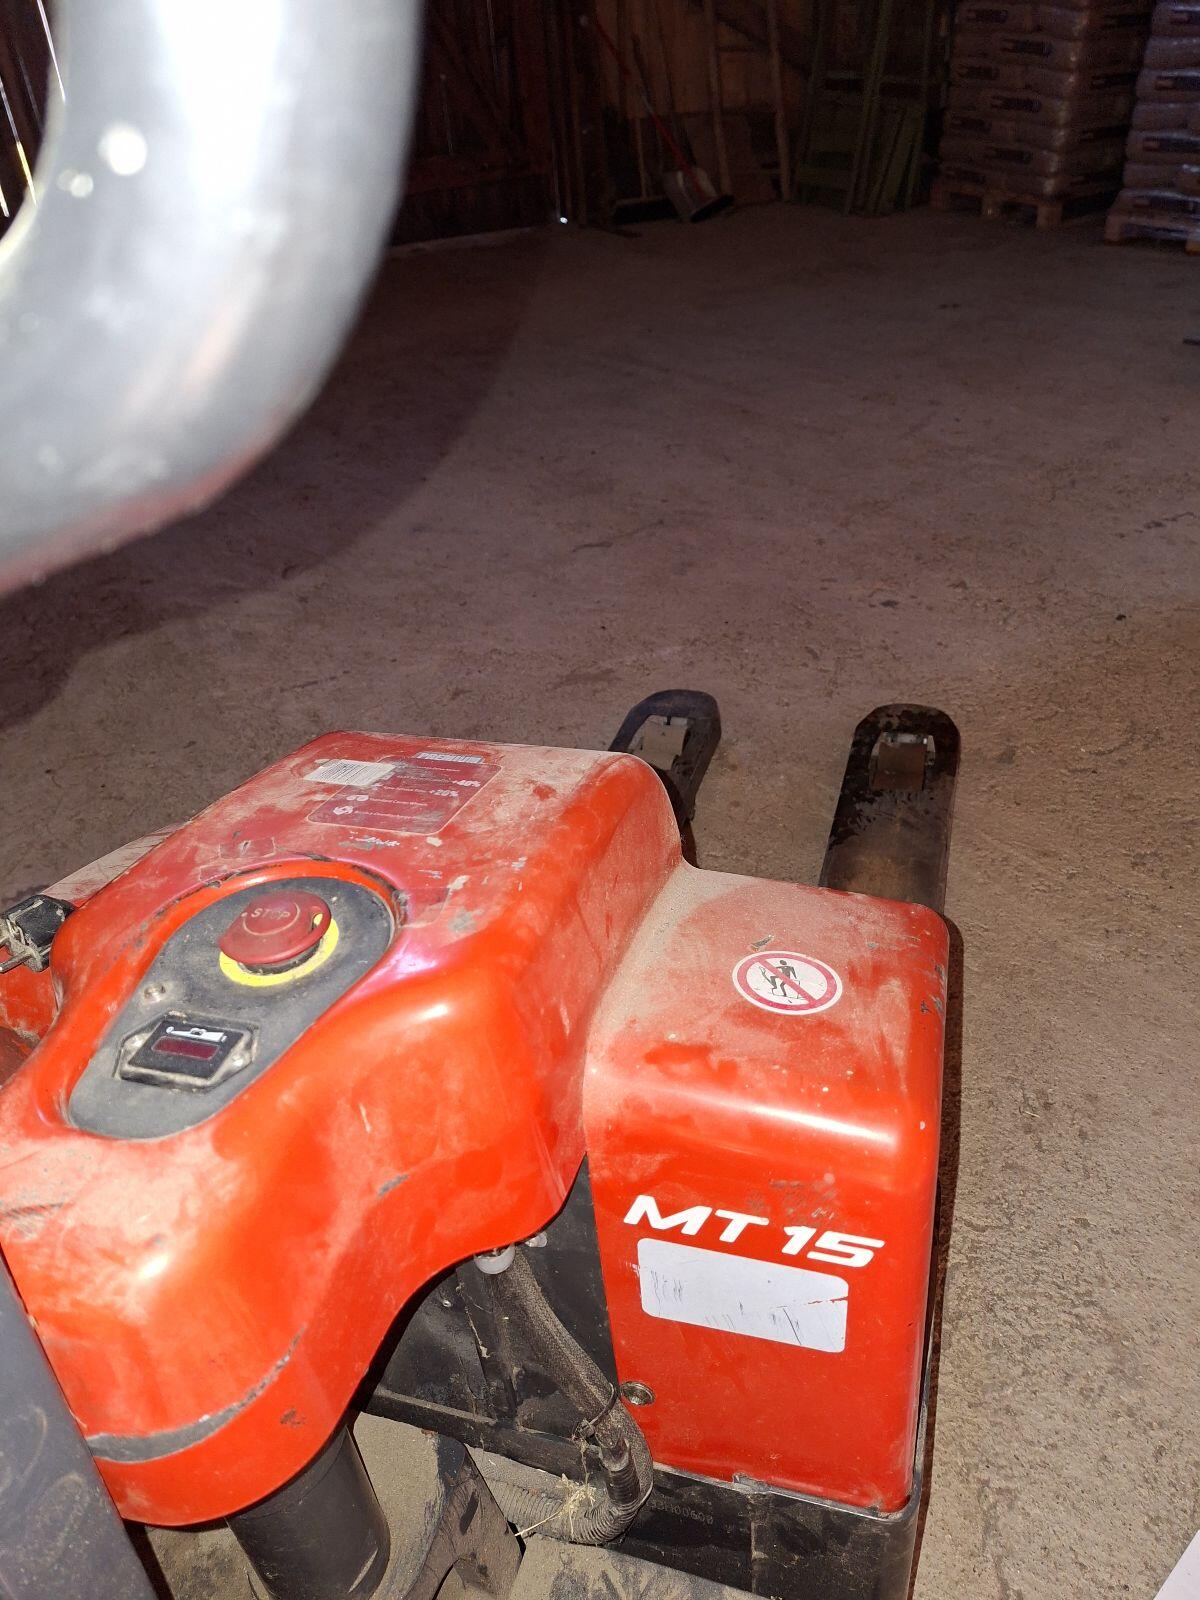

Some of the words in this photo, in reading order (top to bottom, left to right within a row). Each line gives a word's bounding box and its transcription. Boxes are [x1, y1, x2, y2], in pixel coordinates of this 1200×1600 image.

[415, 752, 482, 764] PREMIUM
[250, 907, 291, 920] STOP
[623, 1194, 770, 1243] MT
[781, 1225, 886, 1268] 15
